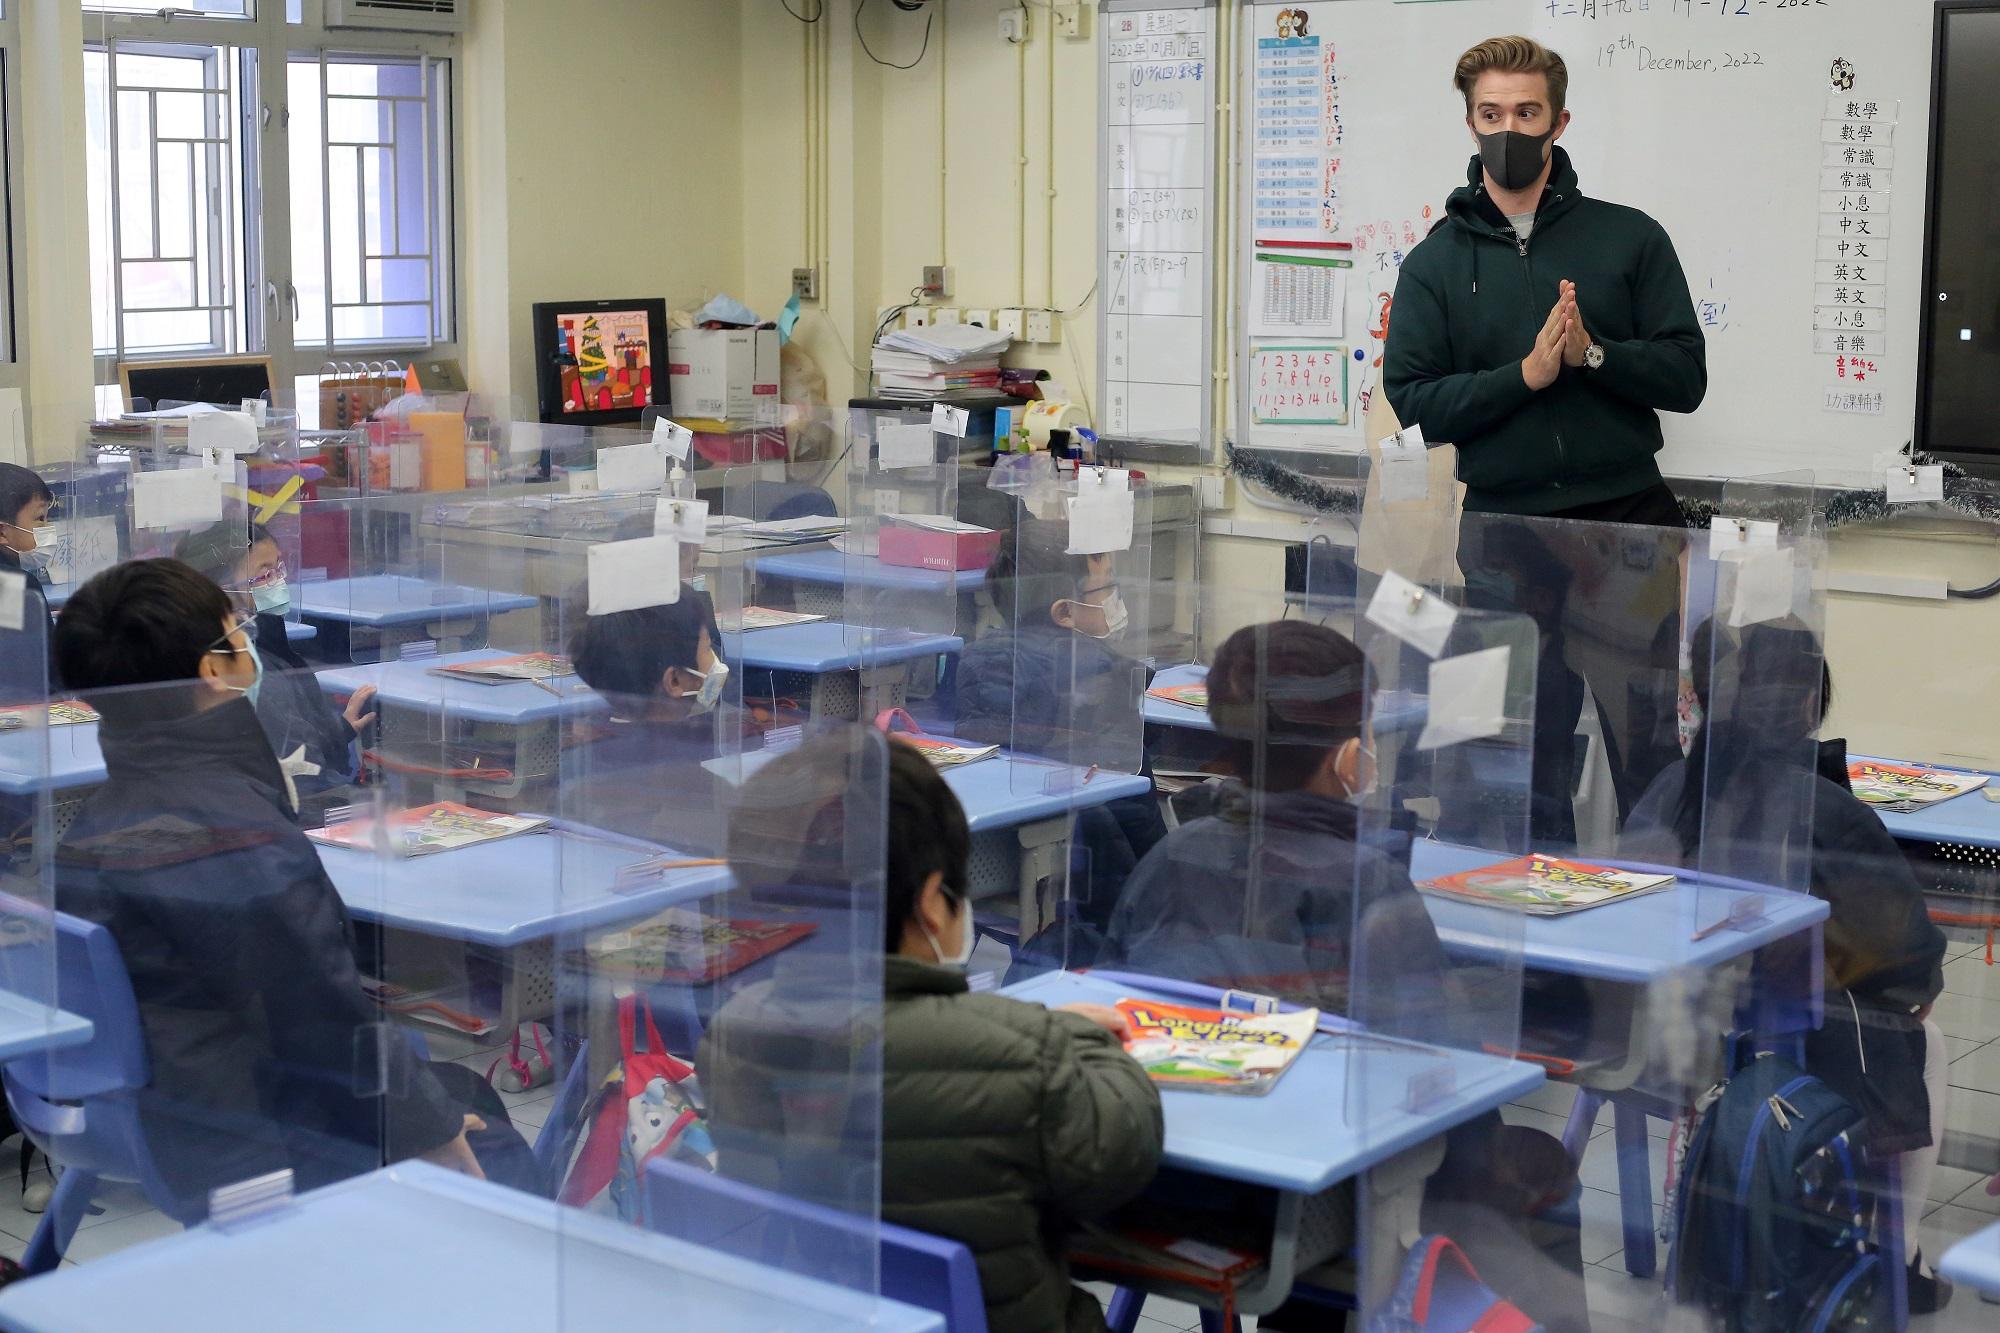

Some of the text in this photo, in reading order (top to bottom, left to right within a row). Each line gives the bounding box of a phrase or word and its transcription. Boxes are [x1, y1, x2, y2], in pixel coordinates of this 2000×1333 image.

[1722, 52, 1764, 68] 2022
[1845, 101, 1878, 119] 數學
[1840, 123, 1873, 142] 數學
[1843, 147, 1875, 165] 常識
[1840, 171, 1872, 189] 常識
[1838, 194, 1870, 212] 小息
[1840, 216, 1871, 235] 中文
[1837, 240, 1869, 258] 中文
[1834, 263, 1867, 281] 英文
[1834, 287, 1866, 304] 英文
[1834, 310, 1865, 328] 小息
[1834, 334, 1866, 352] 音樂
[1275, 356, 1284, 367] 2
[1291, 354, 1299, 367] 3
[1307, 355, 1316, 366] 4
[1323, 353, 1333, 365] 5
[1277, 372, 1283, 384] 7
[1290, 370, 1297, 386] 8
[1303, 368, 1310, 387] 9
[1273, 395, 1286, 406] 12
[1291, 393, 1304, 406] 13
